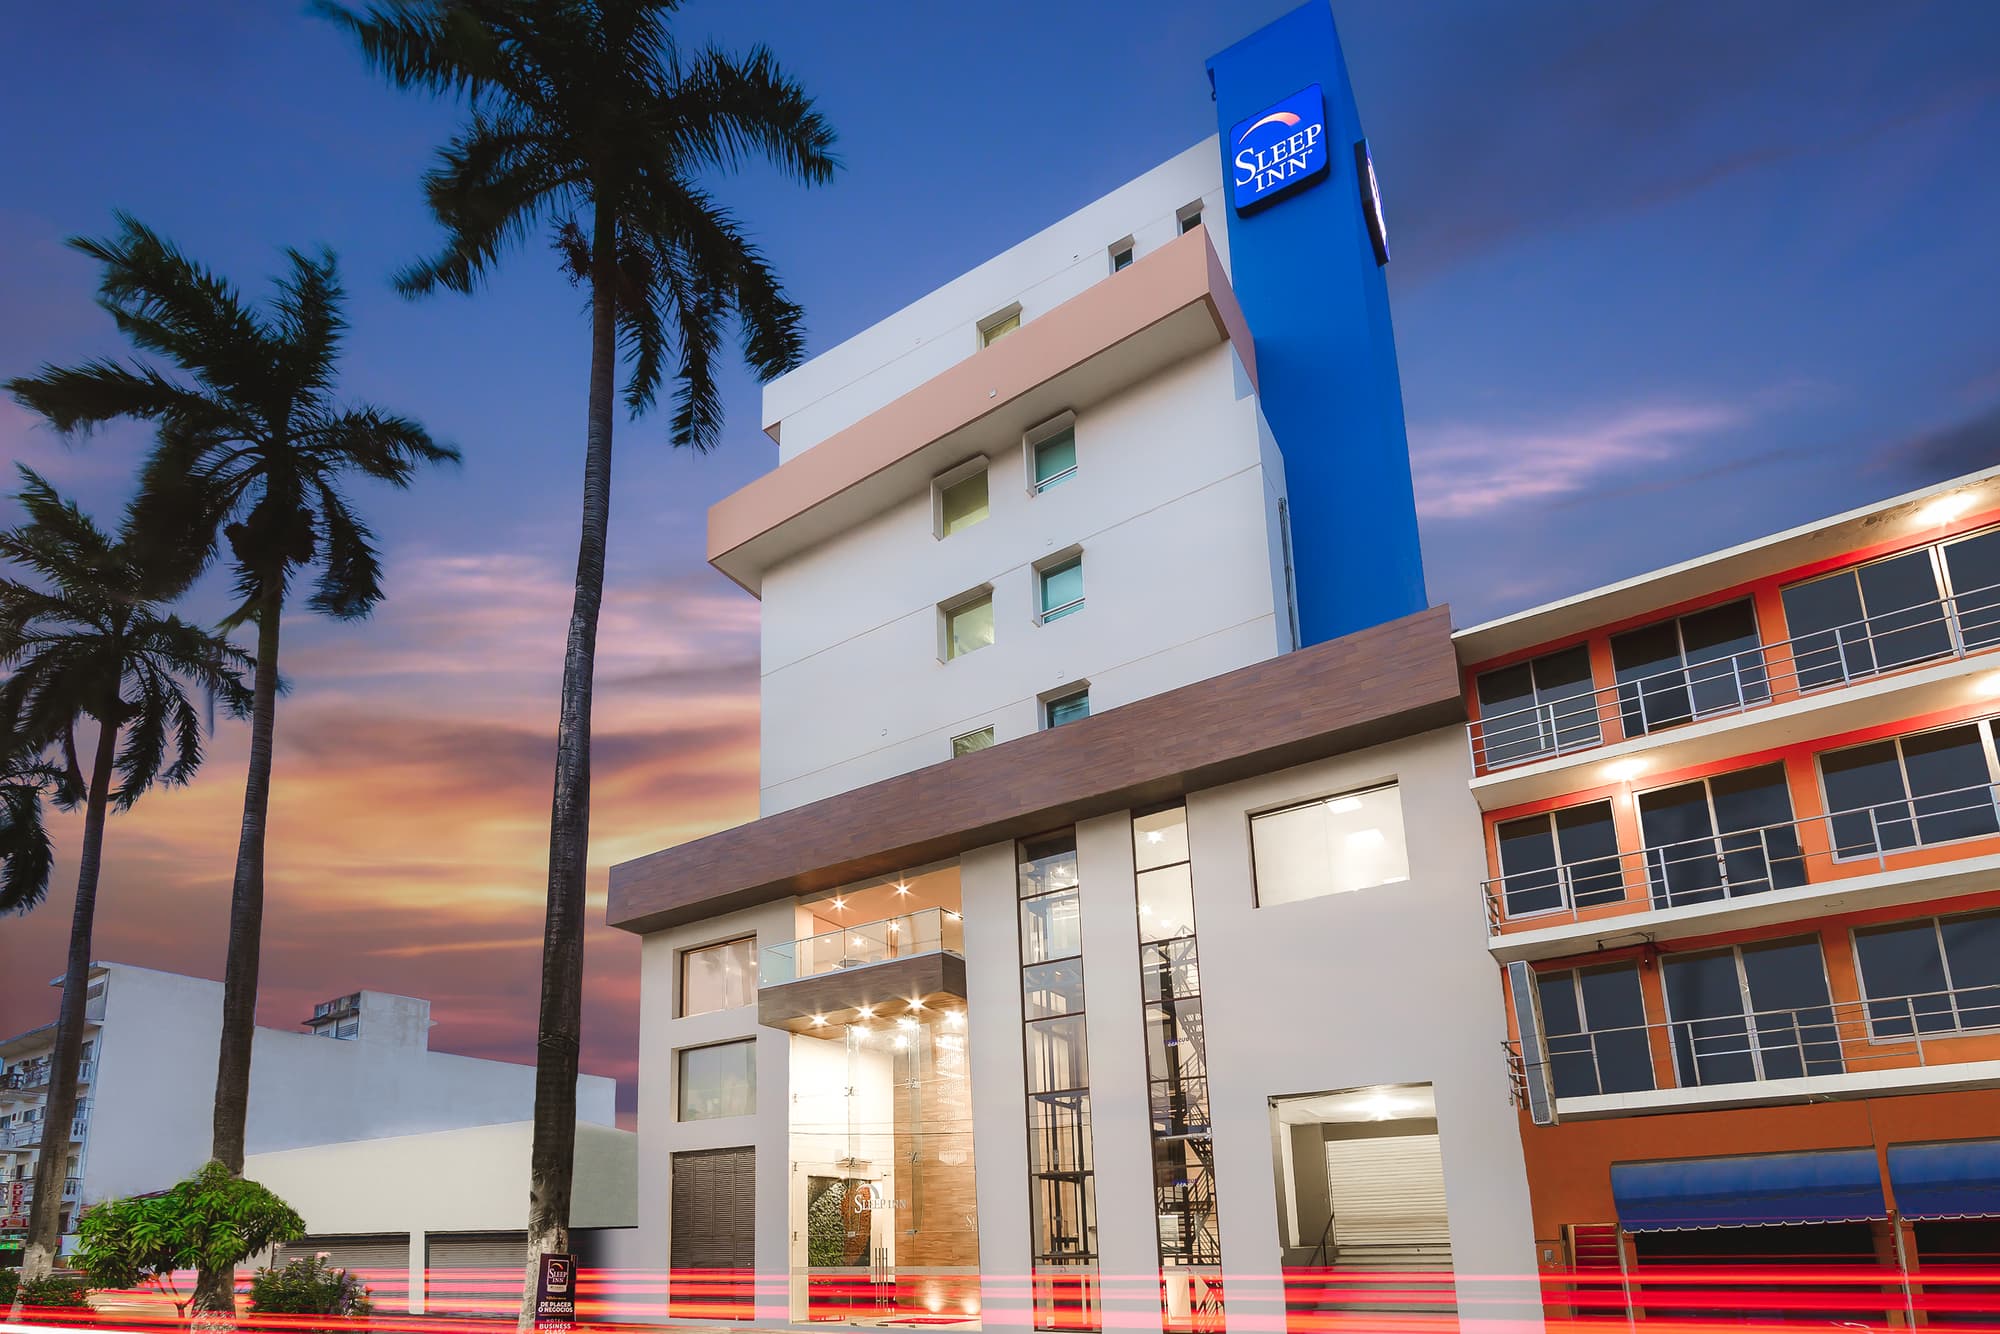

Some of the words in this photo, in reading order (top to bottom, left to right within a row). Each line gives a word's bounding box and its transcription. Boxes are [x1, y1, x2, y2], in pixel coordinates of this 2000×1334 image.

[1235, 124, 1322, 187] SLEEP
[1255, 151, 1308, 193] INN
[854, 1194, 886, 1214] SLEEP
[549, 1268, 568, 1279] SLEEP
